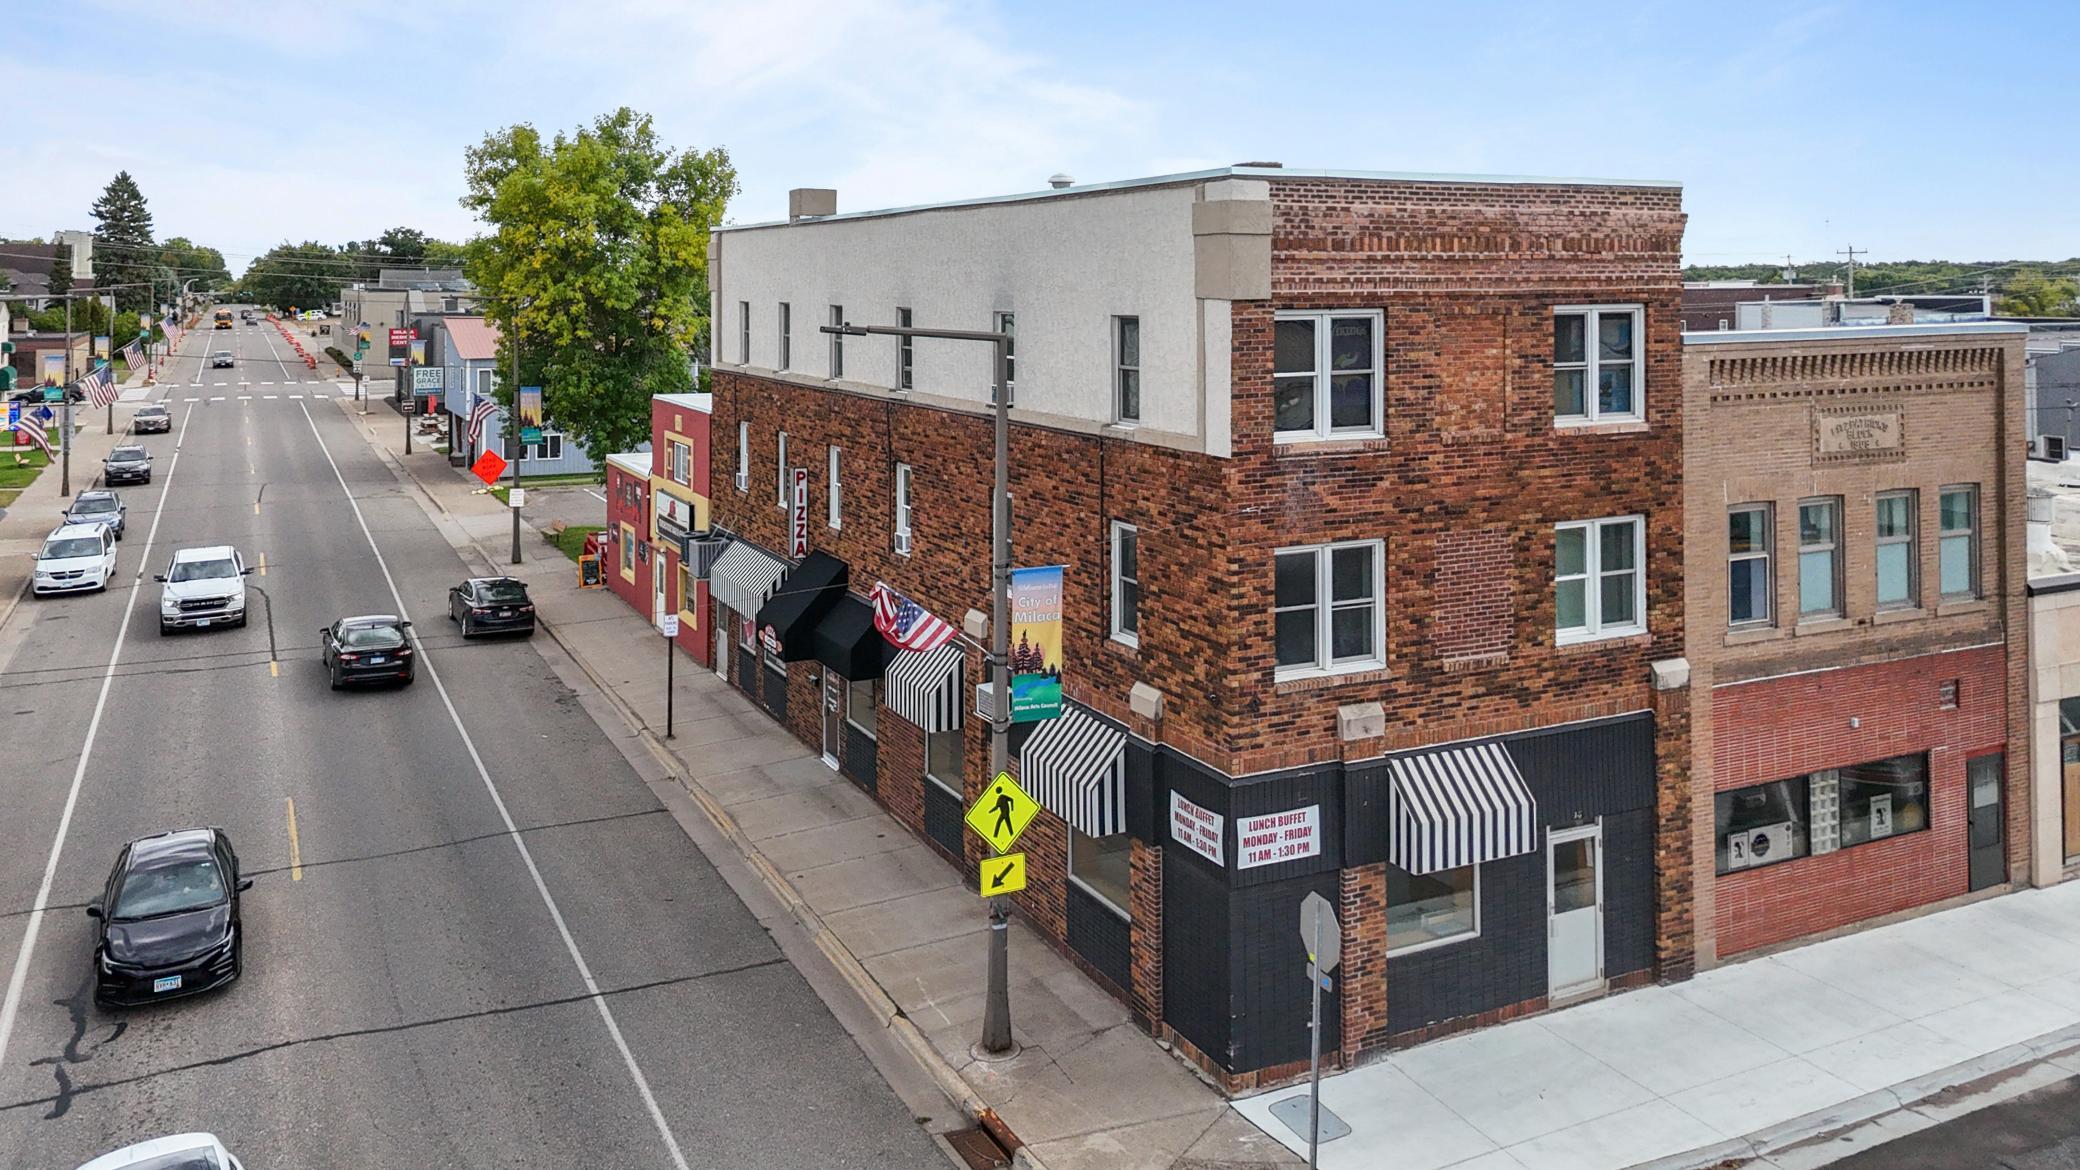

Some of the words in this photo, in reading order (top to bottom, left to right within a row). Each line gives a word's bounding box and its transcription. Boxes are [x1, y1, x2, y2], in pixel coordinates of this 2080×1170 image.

[795, 471, 806, 557] PIZZA
[1018, 596, 1040, 608] City
[1045, 594, 1058, 605] of
[1014, 610, 1060, 623] Milaca
[1177, 798, 1194, 816] LUNCH
[1195, 807, 1214, 826] BUFFET
[1249, 817, 1276, 832] LUNCH
[1278, 812, 1306, 827] BUFFET
[1174, 810, 1195, 831] MONDAY
[1200, 825, 1218, 843] FRIDAY
[1243, 832, 1278, 848] MONDAY
[1284, 826, 1312, 841] FRIDAY
[1178, 827, 1183, 839] 11
[1184, 831, 1191, 844] AM
[1196, 838, 1207, 852] 1:30
[1208, 844, 1216, 858] PM
[1248, 852, 1256, 863] 11
[1258, 849, 1271, 861] AM
[1278, 844, 1295, 857] 1:30
[1297, 842, 1310, 854] PM
